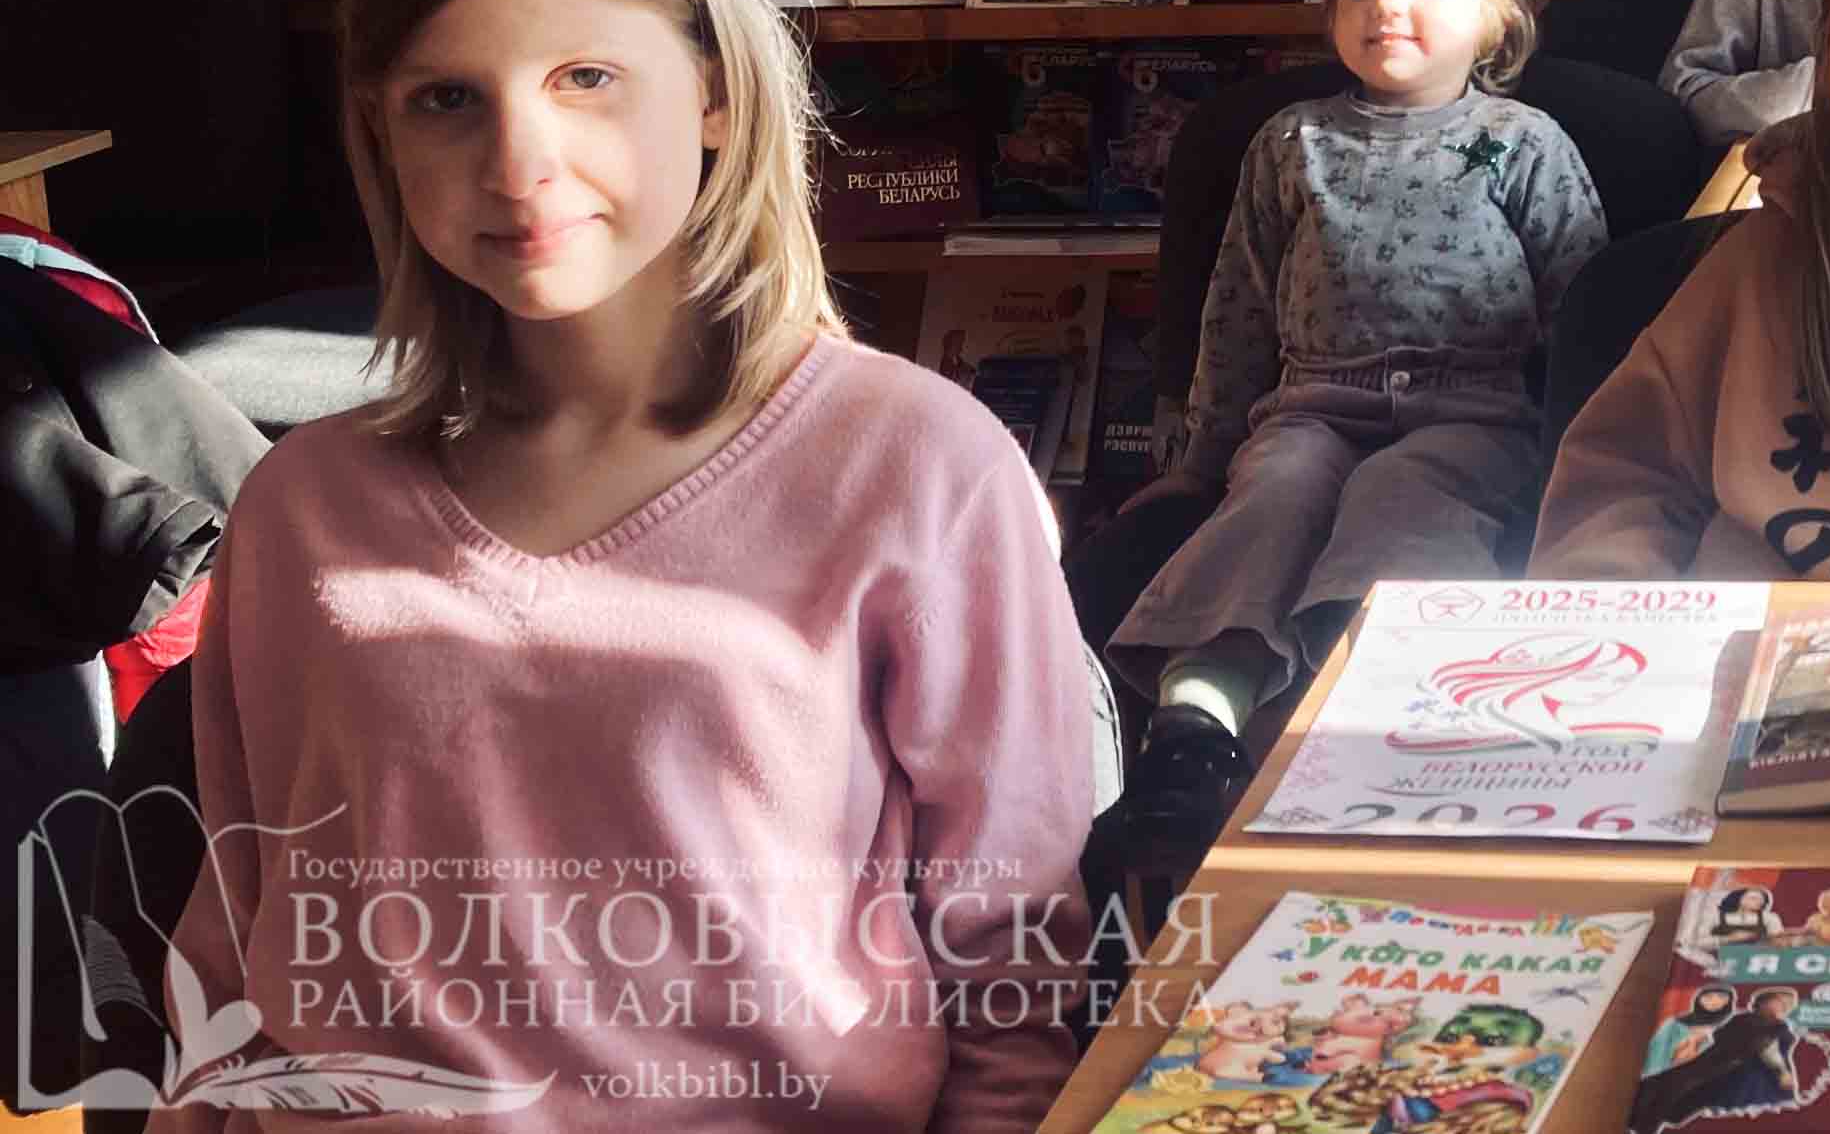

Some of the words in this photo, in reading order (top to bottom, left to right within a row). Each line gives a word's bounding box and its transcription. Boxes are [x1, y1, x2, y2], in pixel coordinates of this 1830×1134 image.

[847, 168, 960, 190] РЕСПУБЛИКИ
[878, 185, 960, 205] БЕЛАРУСЬ
[1499, 588, 1718, 613] 2025-2029
[1419, 759, 1652, 775] БЕЛОРУССКОЙ
[1344, 802, 1639, 834] 2026
[1301, 935, 1336, 959] У
[1340, 938, 1445, 967] КОГО
[1459, 951, 1605, 975] КАКАЯ
[1746, 954, 1779, 975] Я
[1340, 967, 1502, 996] МАМА
